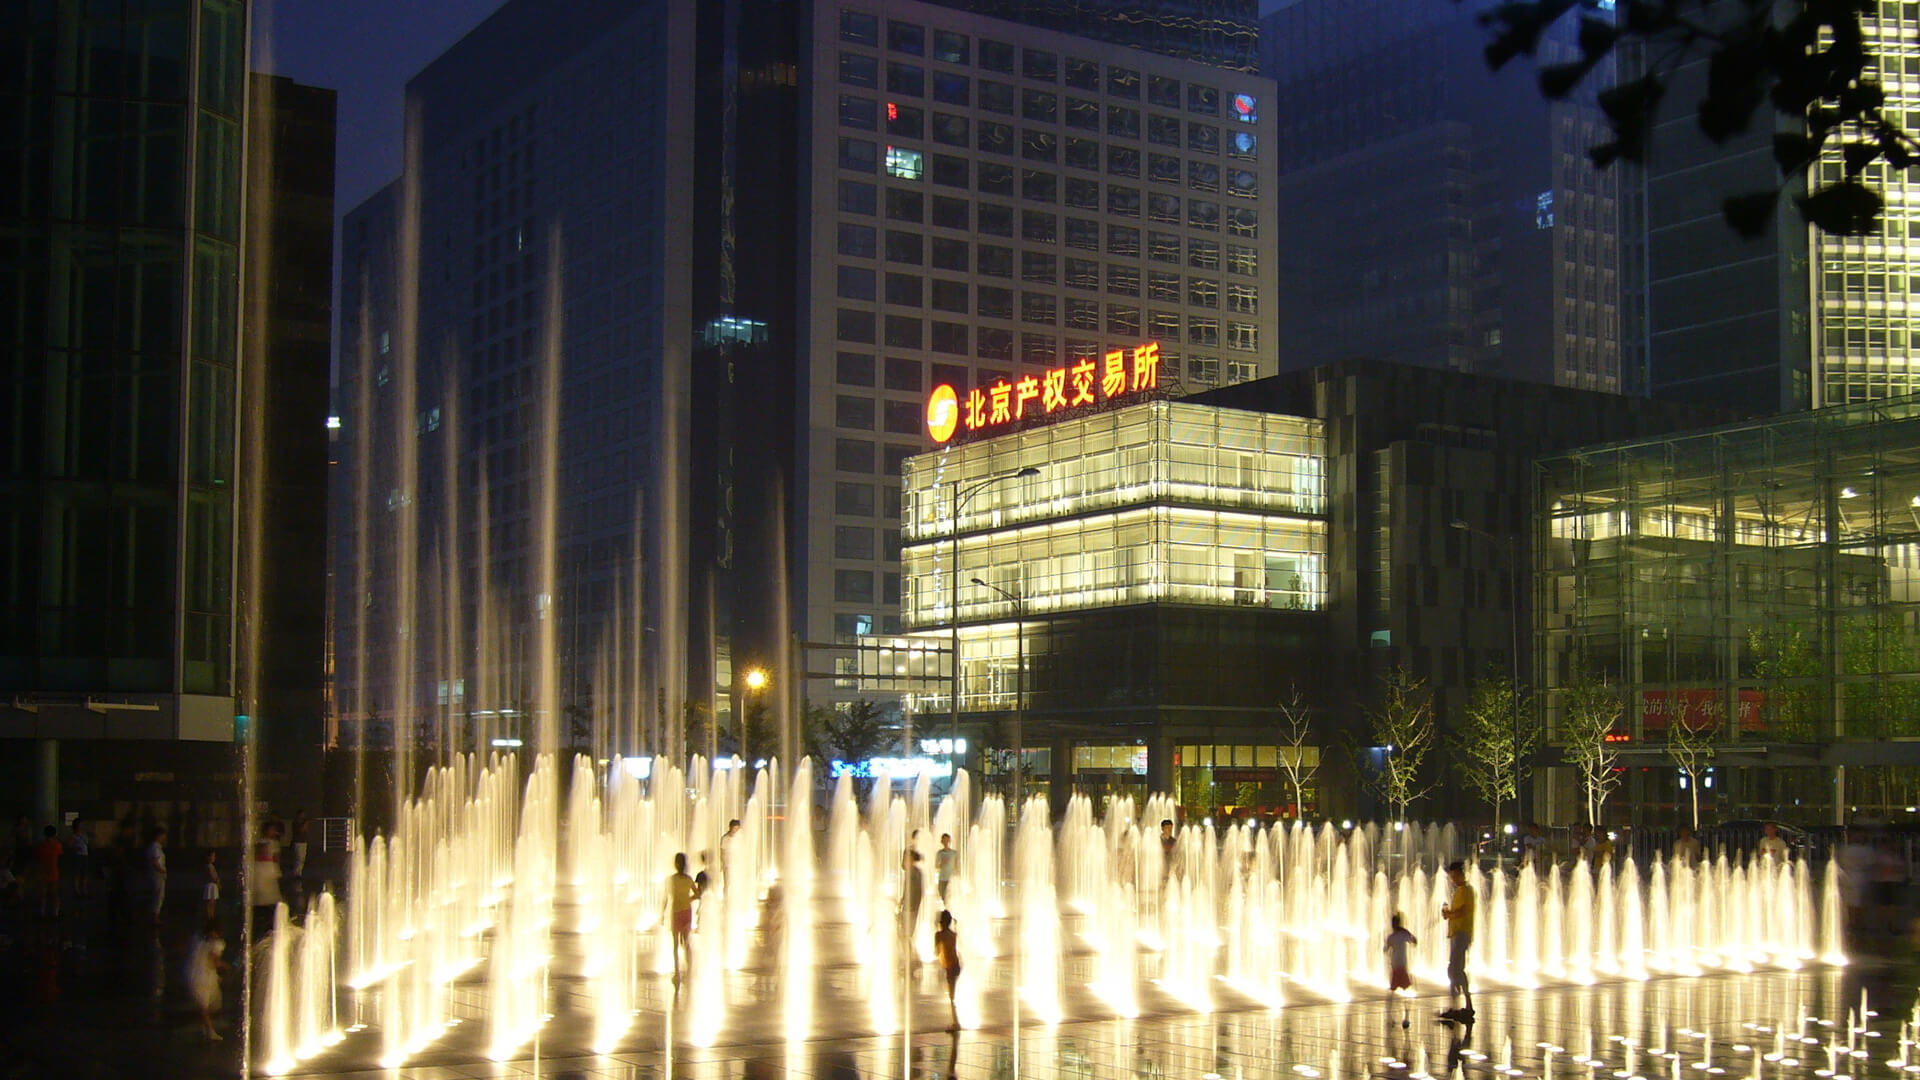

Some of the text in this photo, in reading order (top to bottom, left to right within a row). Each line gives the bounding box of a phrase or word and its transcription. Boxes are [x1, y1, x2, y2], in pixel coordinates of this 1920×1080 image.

[964, 341, 1161, 430] 北京产权交易所
